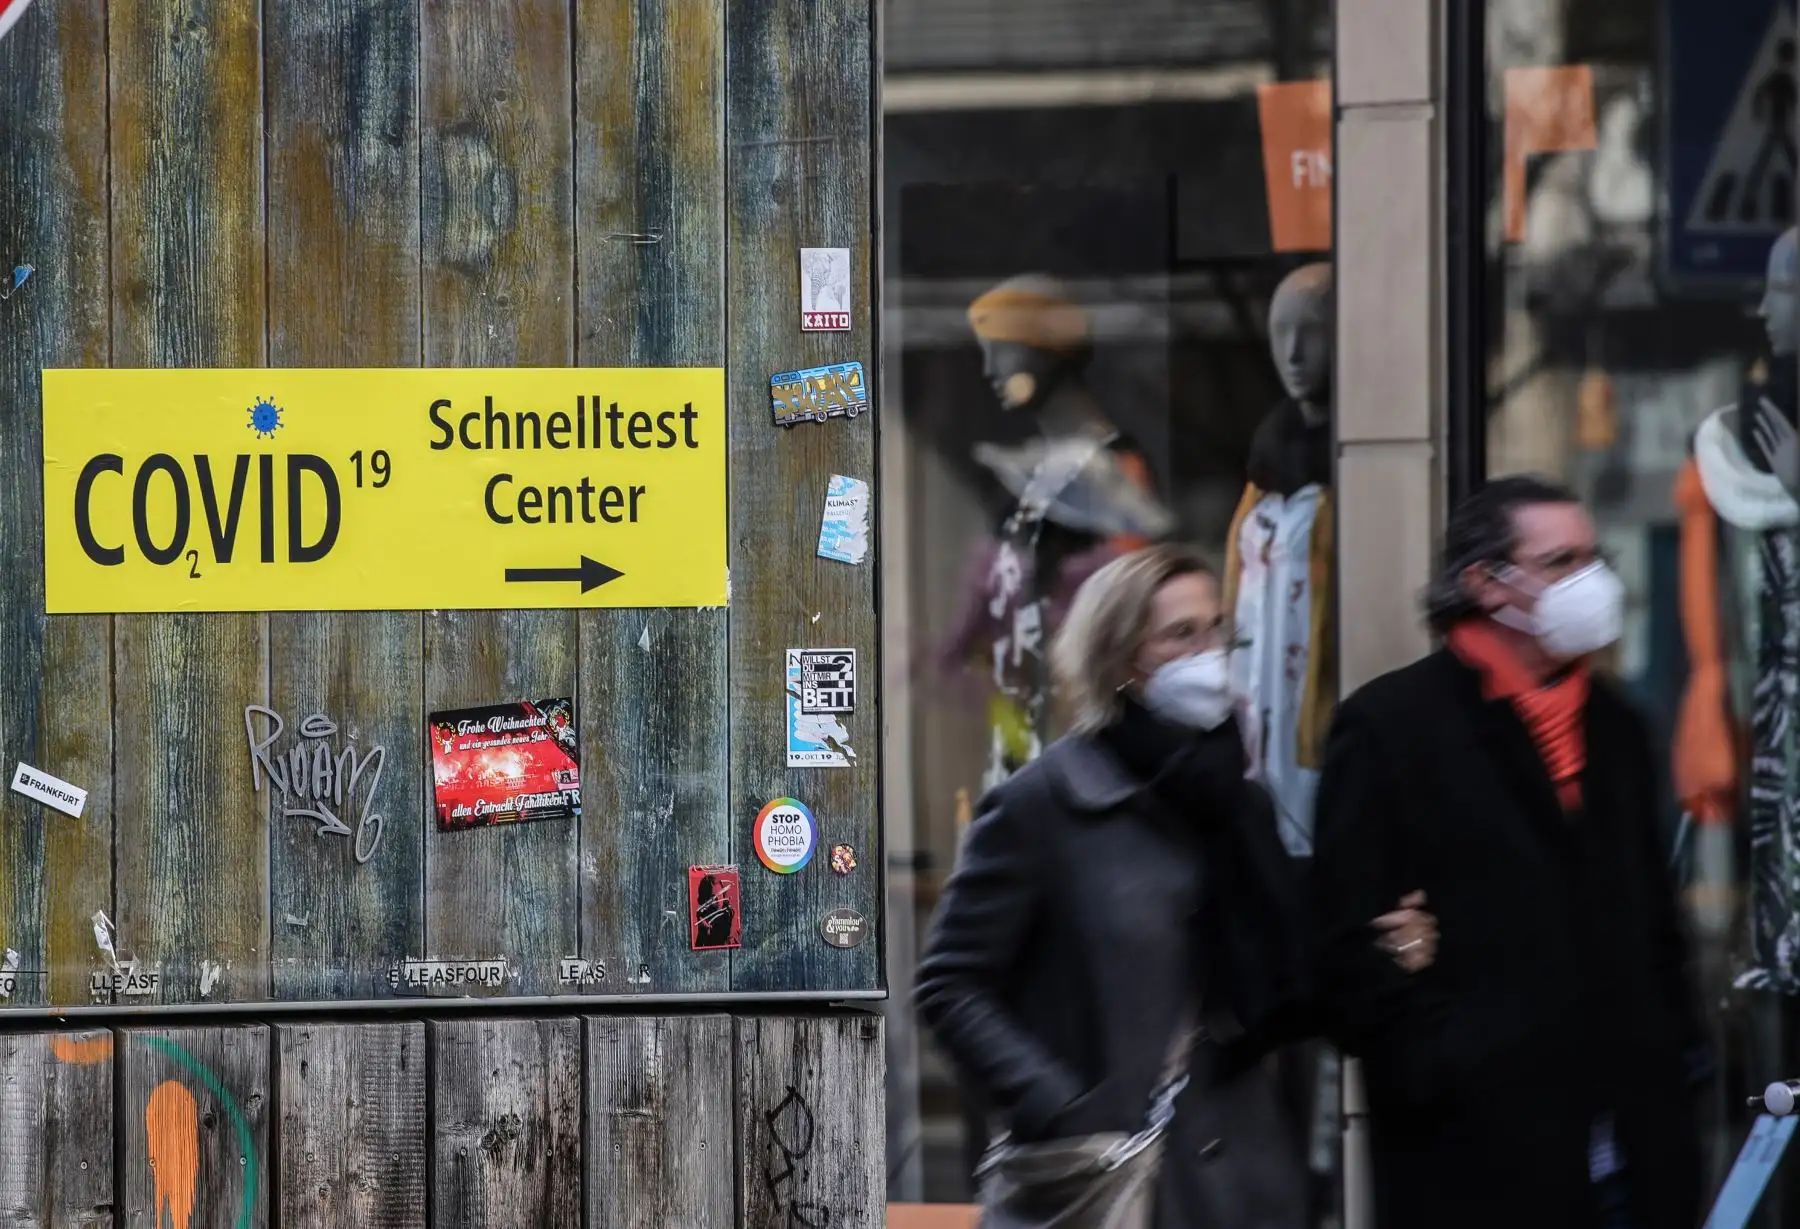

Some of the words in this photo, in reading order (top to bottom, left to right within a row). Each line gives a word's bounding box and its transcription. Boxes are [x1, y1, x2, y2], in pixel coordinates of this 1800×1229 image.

[803, 314, 849, 328] KAITO
[429, 396, 699, 451] Schnelltest
[350, 450, 391, 488] 19
[484, 473, 645, 524] Center
[802, 656, 831, 664] WILLST
[802, 664, 815, 672] DU
[803, 681, 818, 689] INS
[803, 688, 853, 707] BETT
[457, 719, 486, 737] Frohe
[487, 715, 547, 732] Weihnachten
[30, 778, 80, 806] FRANKFURT
[452, 804, 472, 818] allen
[474, 799, 514, 817] Eintracht
[772, 814, 800, 824] STOP
[770, 825, 802, 835] HOMO
[768, 835, 805, 846] PHOBIA
